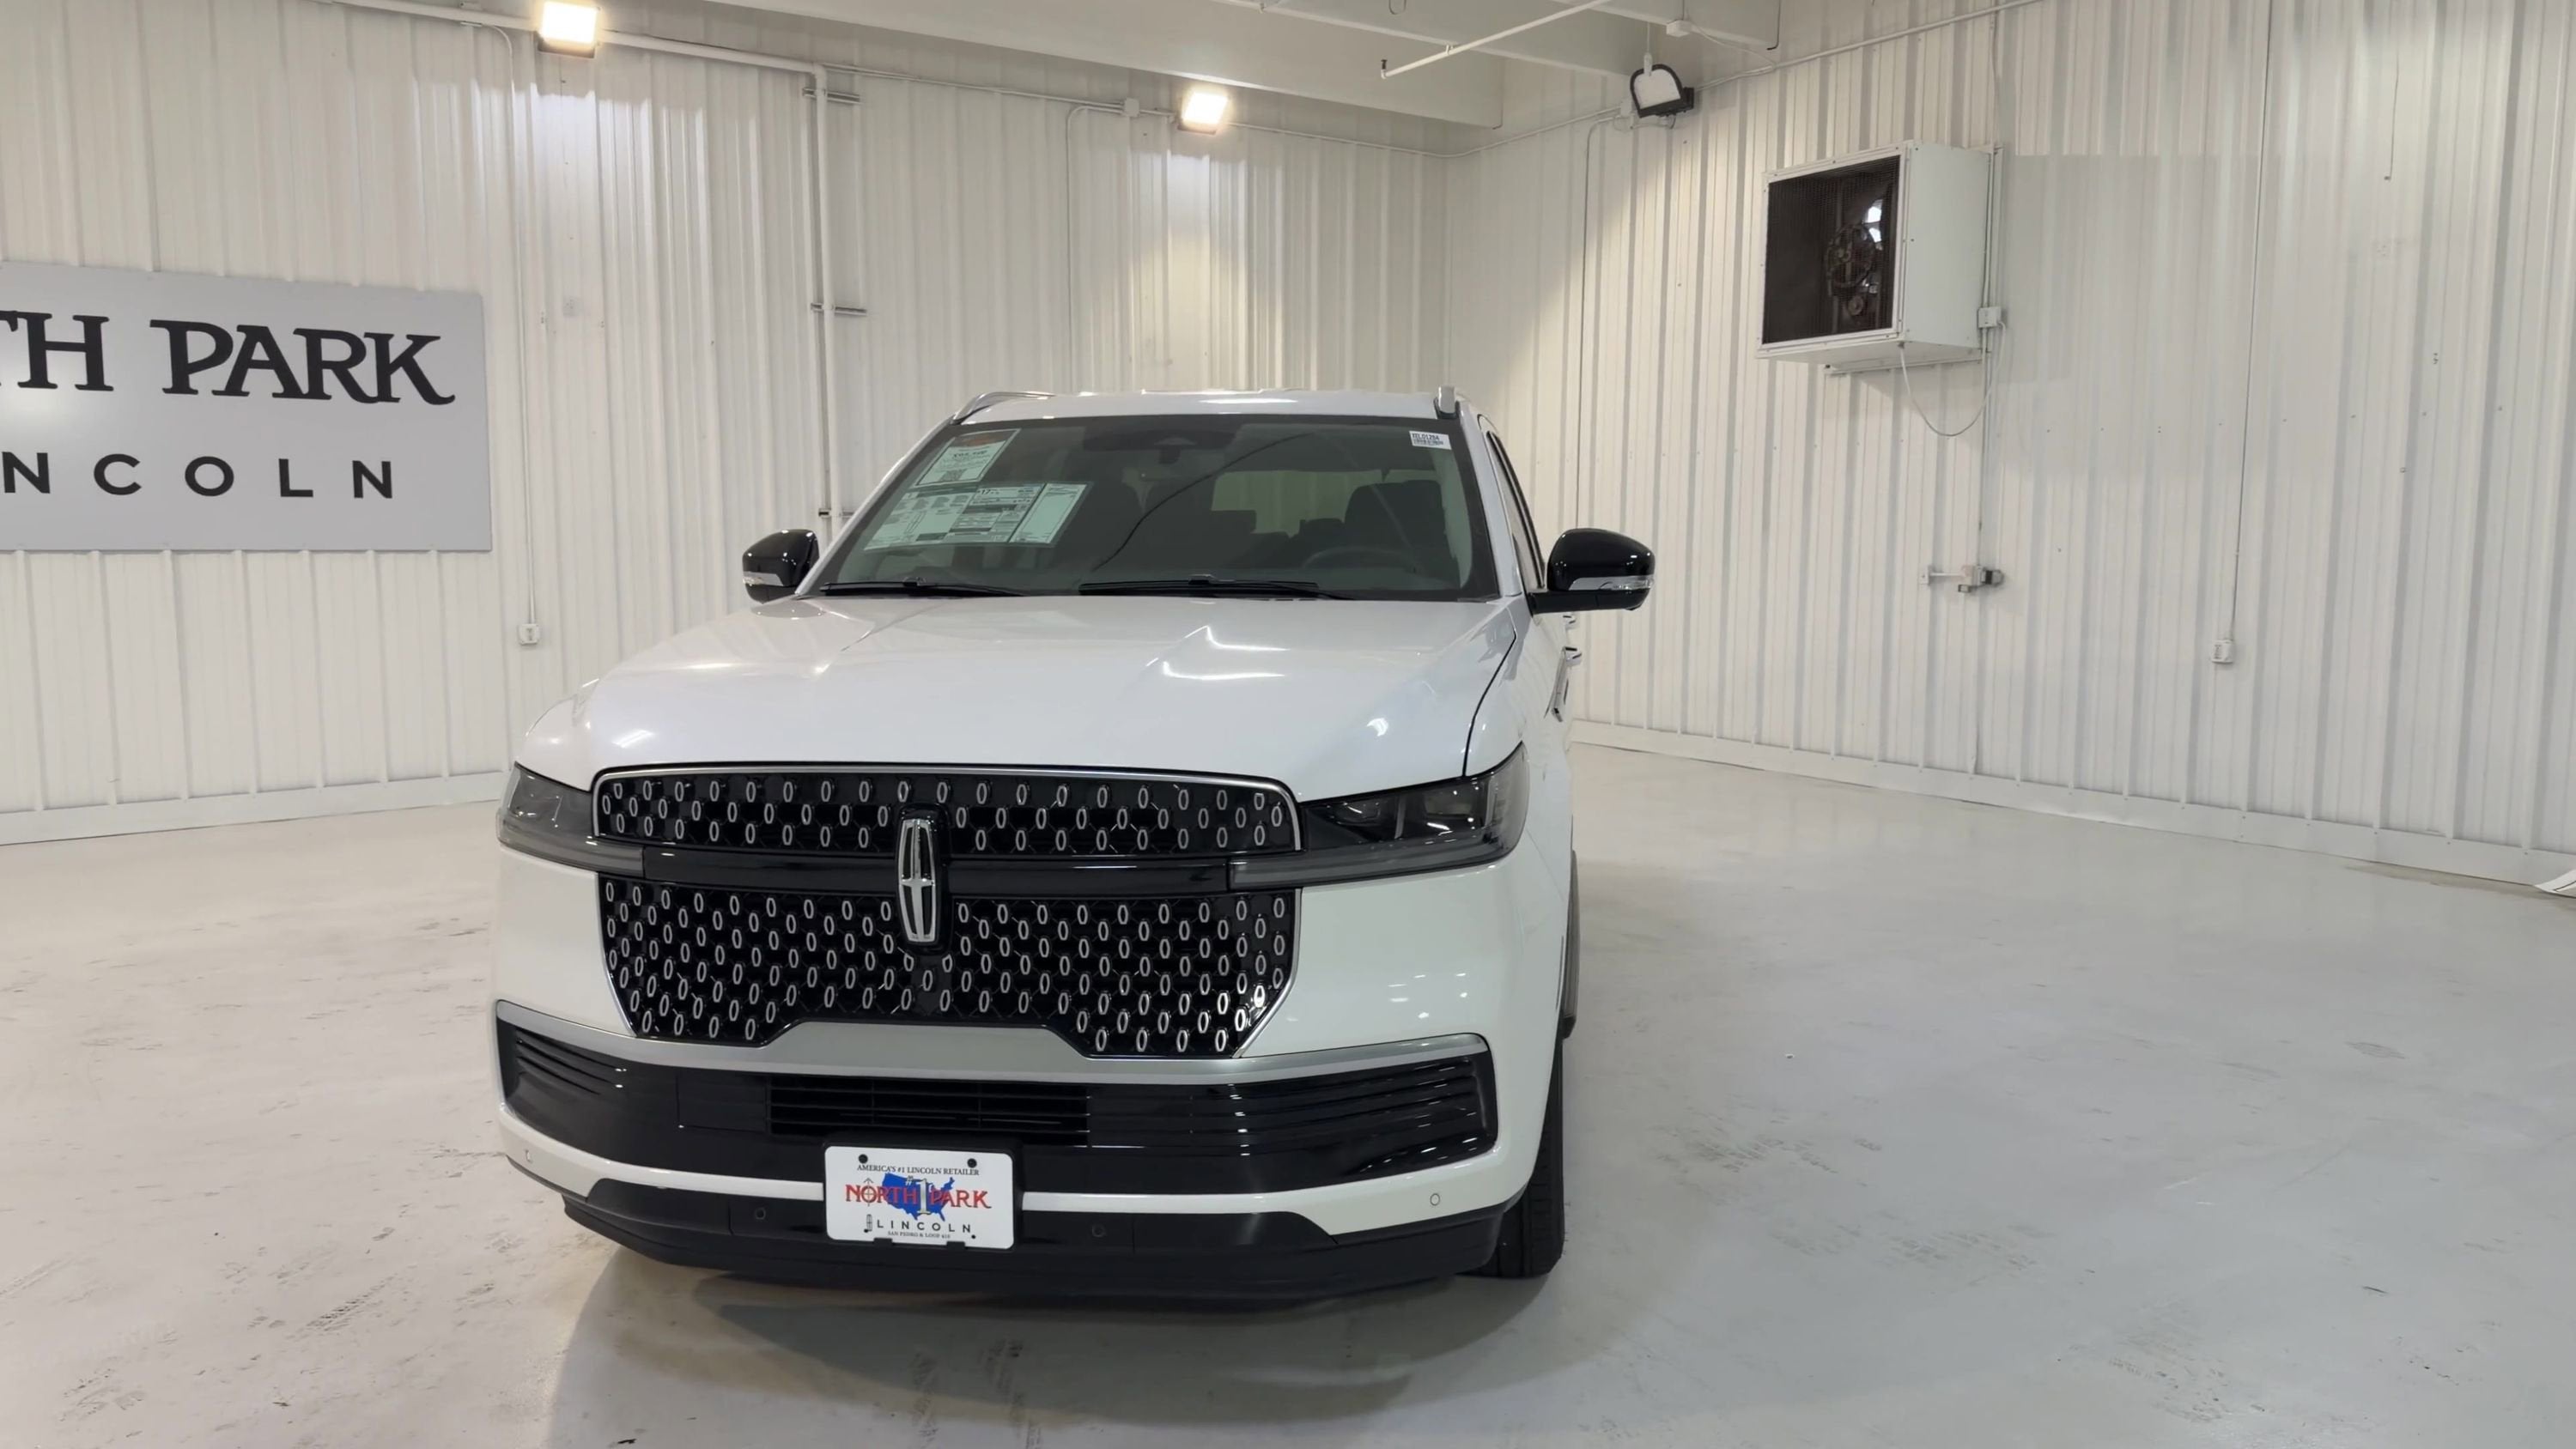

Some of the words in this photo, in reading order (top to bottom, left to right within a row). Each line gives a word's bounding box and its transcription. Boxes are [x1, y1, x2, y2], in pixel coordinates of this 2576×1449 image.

[149, 319, 456, 406] PARK
[857, 1164, 896, 1173] AMERICA'S
[943, 1167, 980, 1176] RETAILER
[845, 1184, 917, 1205] NORTH
[930, 1189, 992, 1209] PARK
[877, 1220, 971, 1234] LINCOLN
